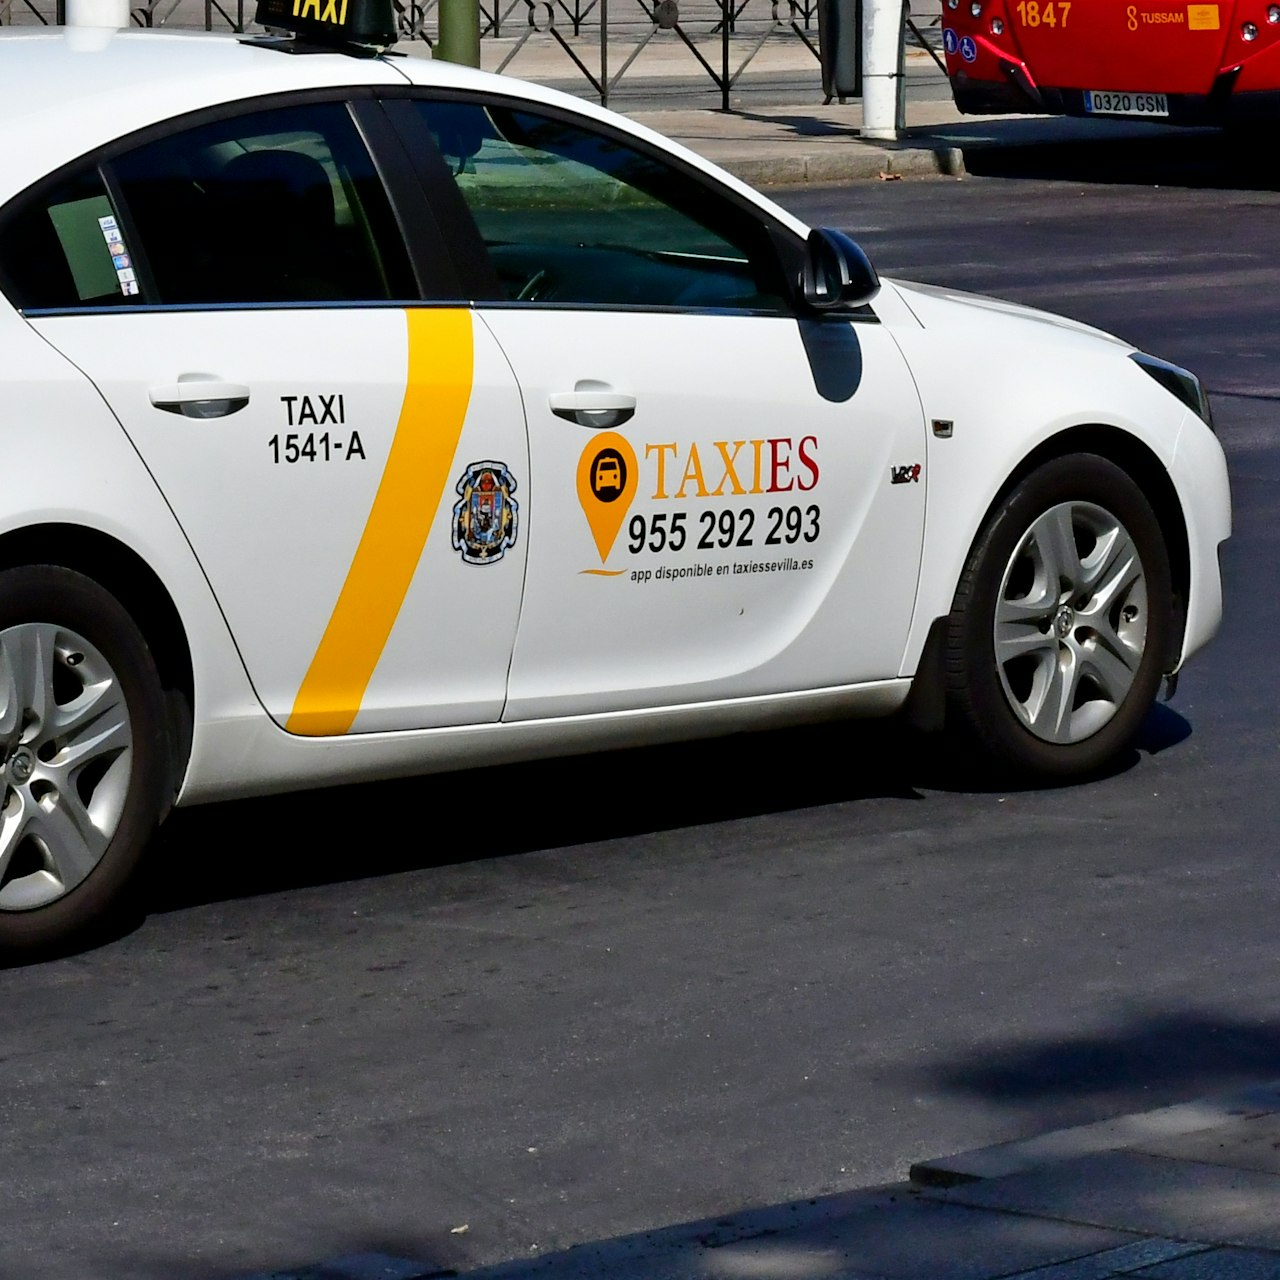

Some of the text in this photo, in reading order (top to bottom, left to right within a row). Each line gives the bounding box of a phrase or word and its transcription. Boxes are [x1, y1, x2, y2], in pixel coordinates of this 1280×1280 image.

[1017, 1, 1071, 27] 1847
[1140, 12, 1184, 24] TUSSAM
[1094, 94, 1166, 113] 0320 GSN
[280, 394, 345, 426] TAXI
[268, 431, 366, 464] 1541-A
[645, 435, 820, 500] TAXIES
[628, 504, 821, 554] 955 292 293
[630, 558, 814, 584] app disponible en taxiessevilla.es
